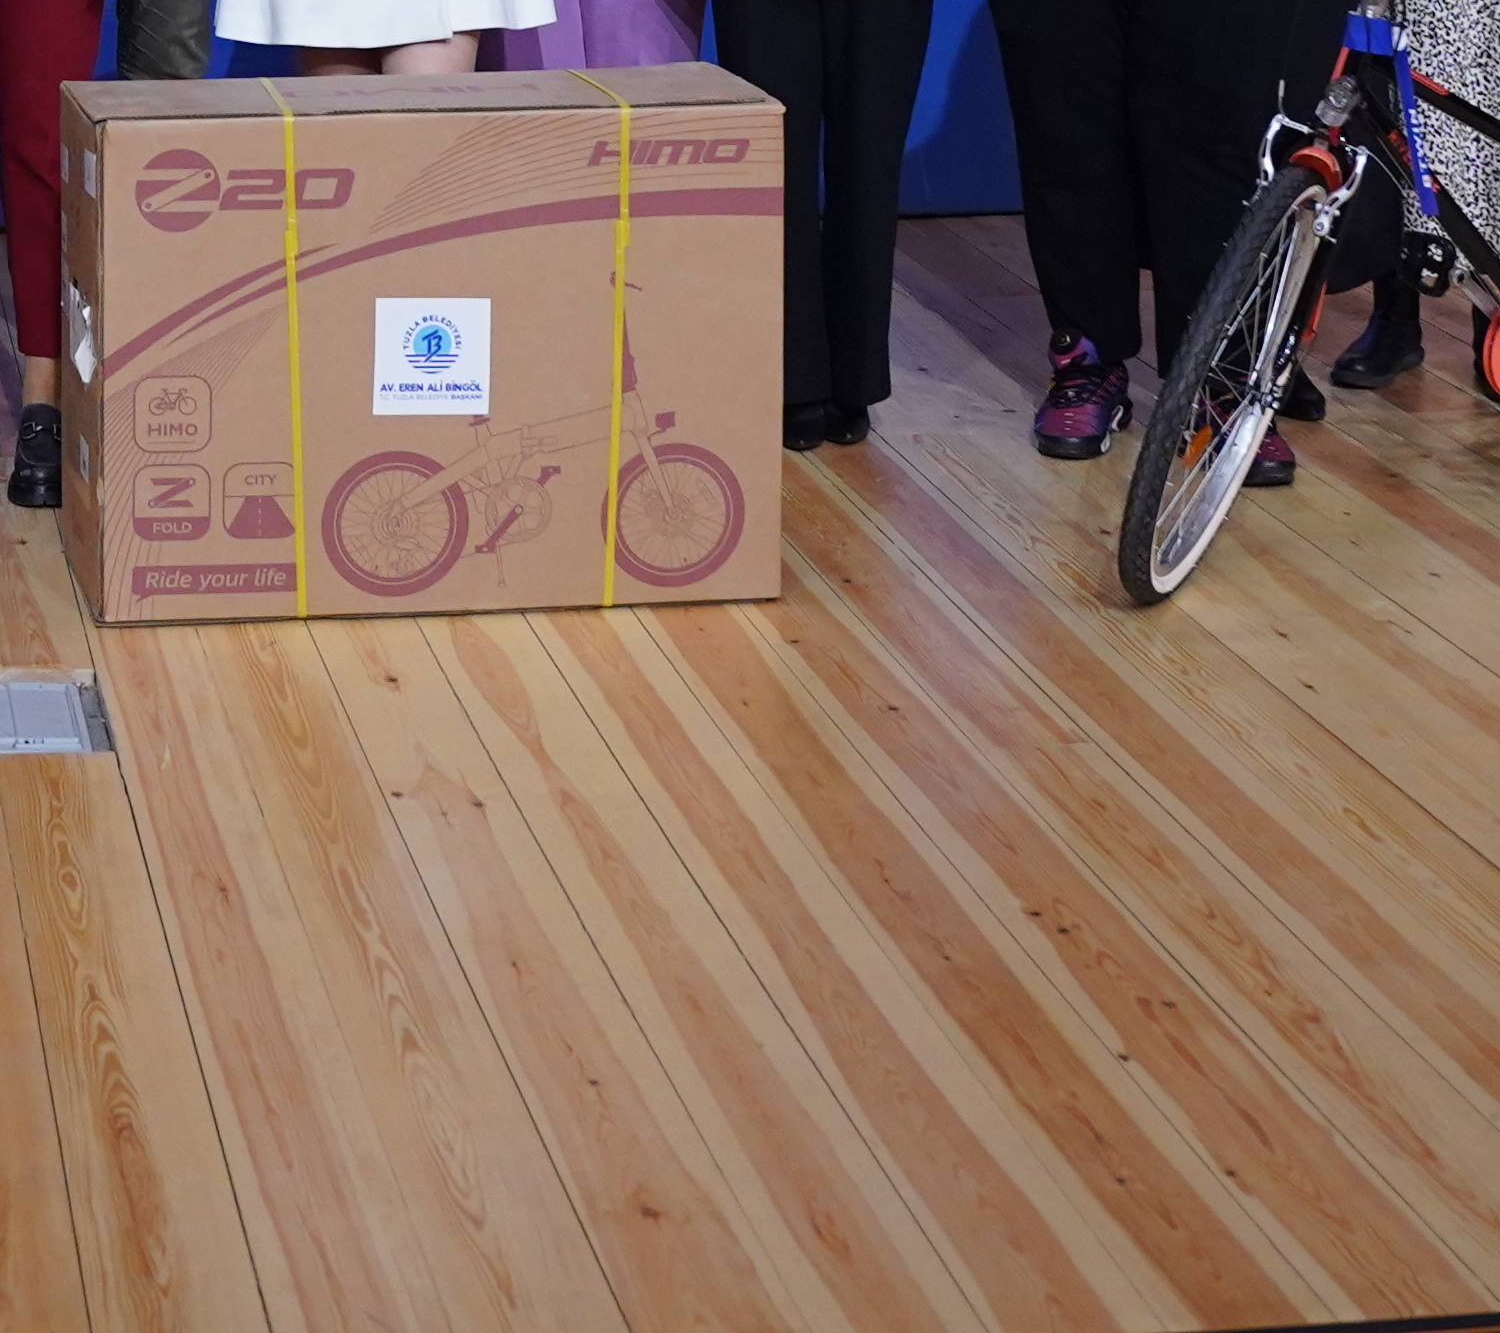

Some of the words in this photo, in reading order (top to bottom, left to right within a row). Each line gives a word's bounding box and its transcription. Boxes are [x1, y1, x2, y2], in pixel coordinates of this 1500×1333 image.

[586, 138, 750, 167] HIMO
[402, 321, 421, 350] TUZLA
[421, 314, 462, 350] BELEDİYESİ
[380, 383, 396, 392] AV.
[398, 383, 424, 392] EREN
[426, 379, 443, 392] ALİ
[445, 379, 483, 392] BİNGÖL
[148, 423, 198, 438] HIMO
[244, 474, 277, 486] CITY
[152, 521, 192, 534] FOLD
[145, 571, 192, 589] Ride
[198, 571, 249, 592] your
[254, 567, 287, 587] life
